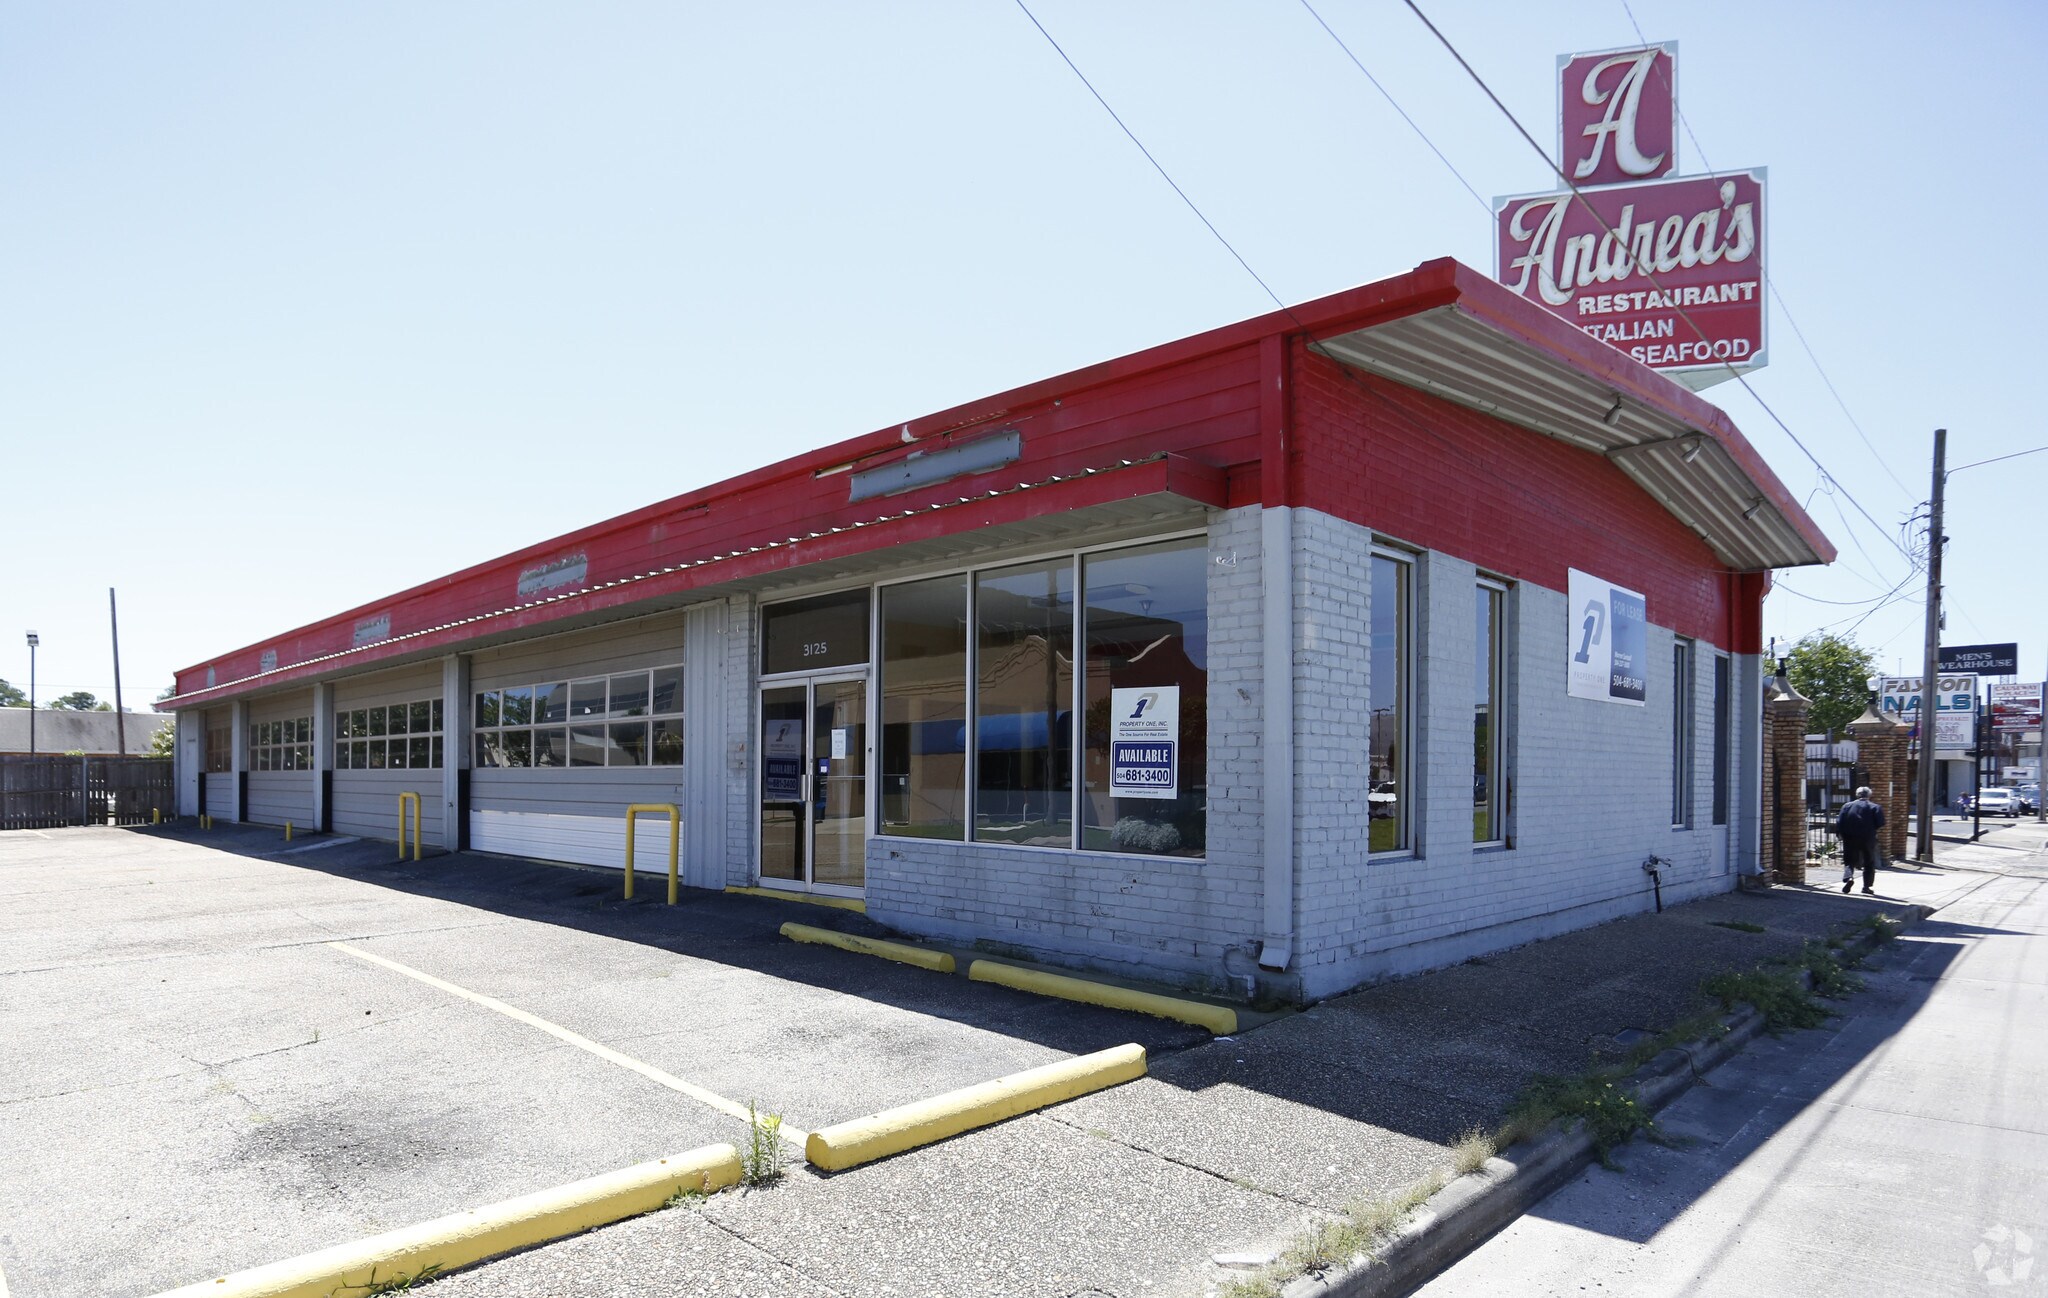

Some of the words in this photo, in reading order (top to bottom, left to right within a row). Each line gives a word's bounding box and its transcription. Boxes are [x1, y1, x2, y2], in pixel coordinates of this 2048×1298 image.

[1574, 47, 1665, 180] A
[1506, 180, 1754, 306] Andrea's
[1578, 281, 1758, 315] RESTAURANT
[1631, 337, 1751, 365] SEAFOOD
[1613, 600, 1626, 617] FOR
[1627, 604, 1643, 622] LEASE
[803, 642, 827, 657] 3125
[1955, 652, 1992, 662] MEN'S
[1884, 694, 1971, 711] NALS
[1118, 749, 1168, 763] AVAILABLE
[769, 763, 797, 775] AVAILABLE
